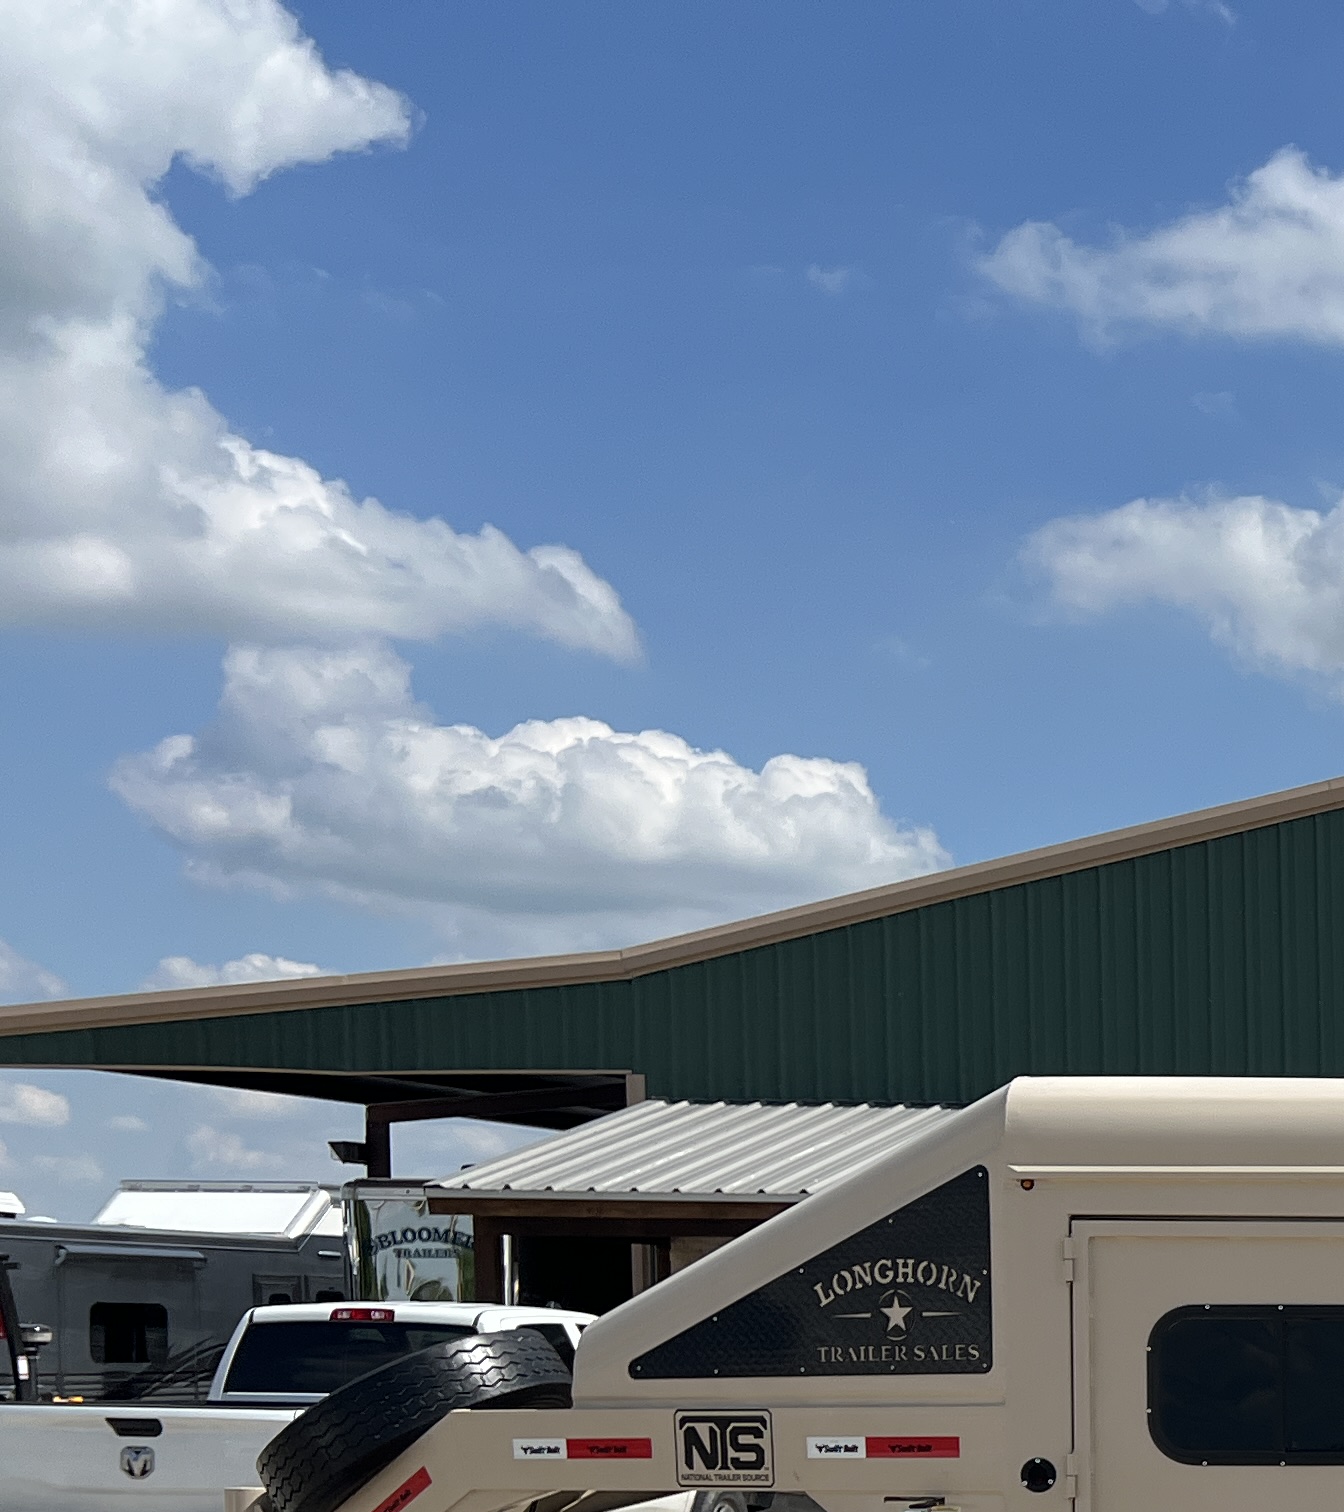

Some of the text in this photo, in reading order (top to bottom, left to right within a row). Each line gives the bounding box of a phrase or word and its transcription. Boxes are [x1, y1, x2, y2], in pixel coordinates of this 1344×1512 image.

[813, 1258, 982, 1308] LONGHORN
[816, 1344, 980, 1363] TRAILER SALES
[679, 1416, 766, 1470] NTS
